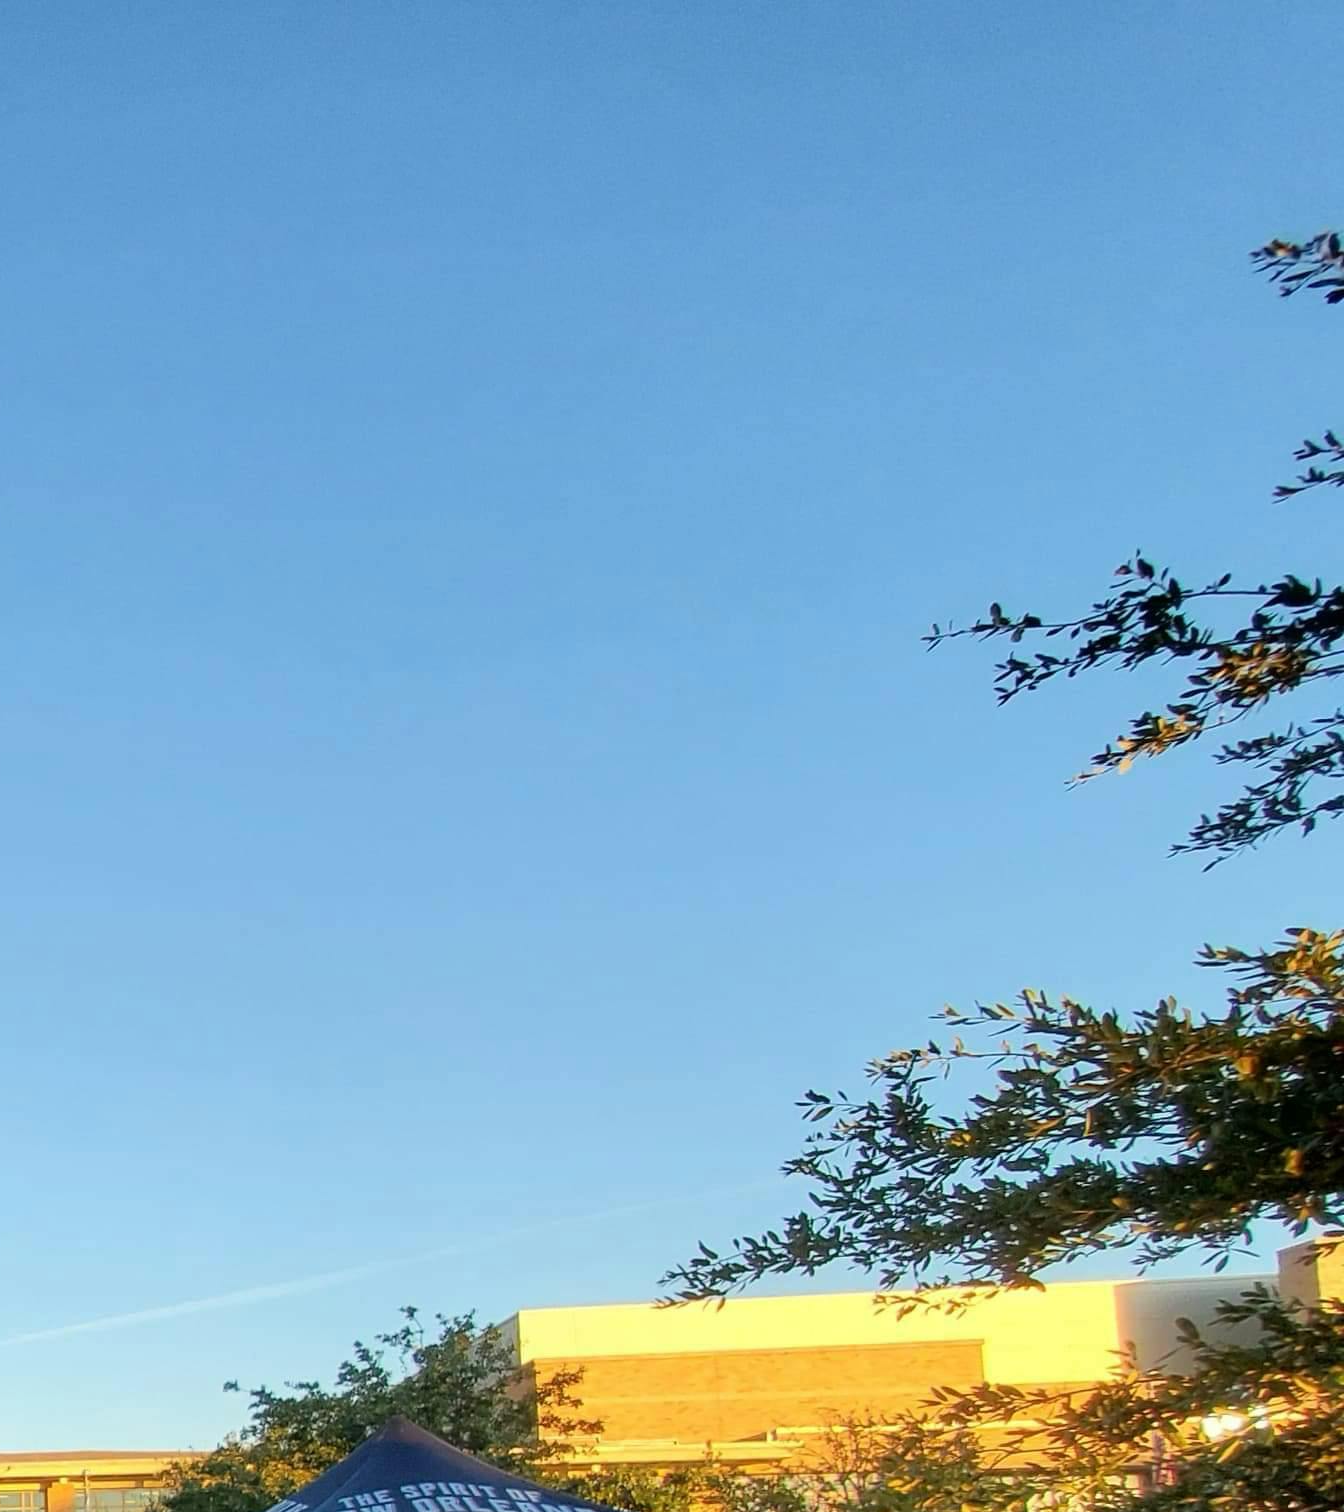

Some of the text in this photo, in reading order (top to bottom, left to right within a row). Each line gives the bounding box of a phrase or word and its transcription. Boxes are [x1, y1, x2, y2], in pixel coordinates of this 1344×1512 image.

[337, 1482, 542, 1510] THE SPIRIT OF
